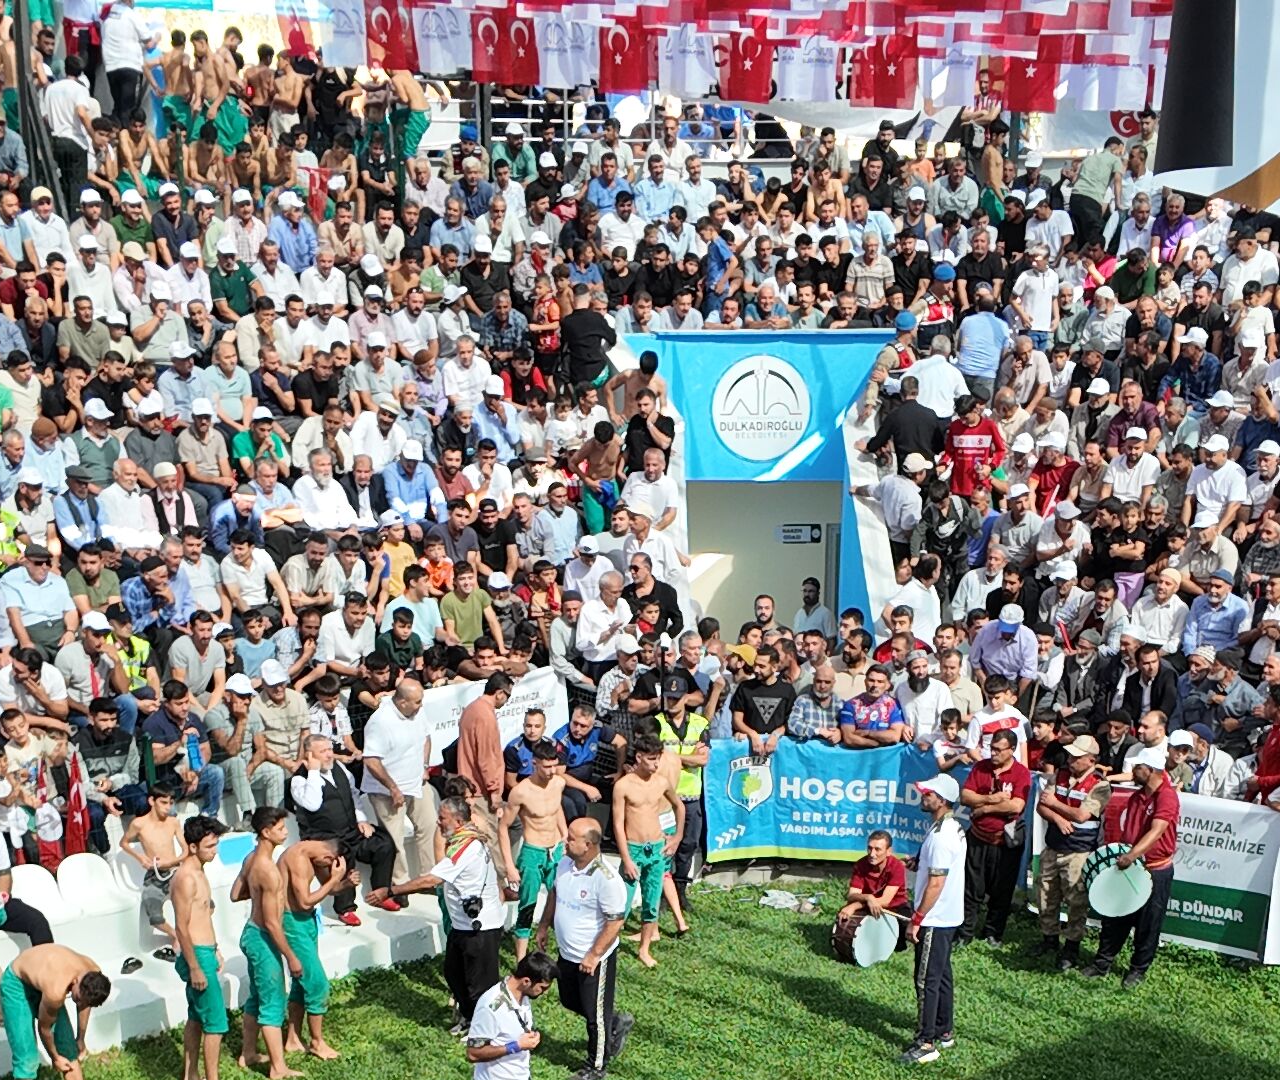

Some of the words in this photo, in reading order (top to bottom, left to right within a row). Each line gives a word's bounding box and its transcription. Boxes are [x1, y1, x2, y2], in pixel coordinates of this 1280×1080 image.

[780, 776, 922, 806] HOŞGELD
[780, 823, 864, 837] YARDIMLAŞMA
[855, 811, 908, 827] EĞİTİM
[1176, 831, 1266, 855] ECİLERİMİZE
[1183, 899, 1243, 922] DÜNDAR
